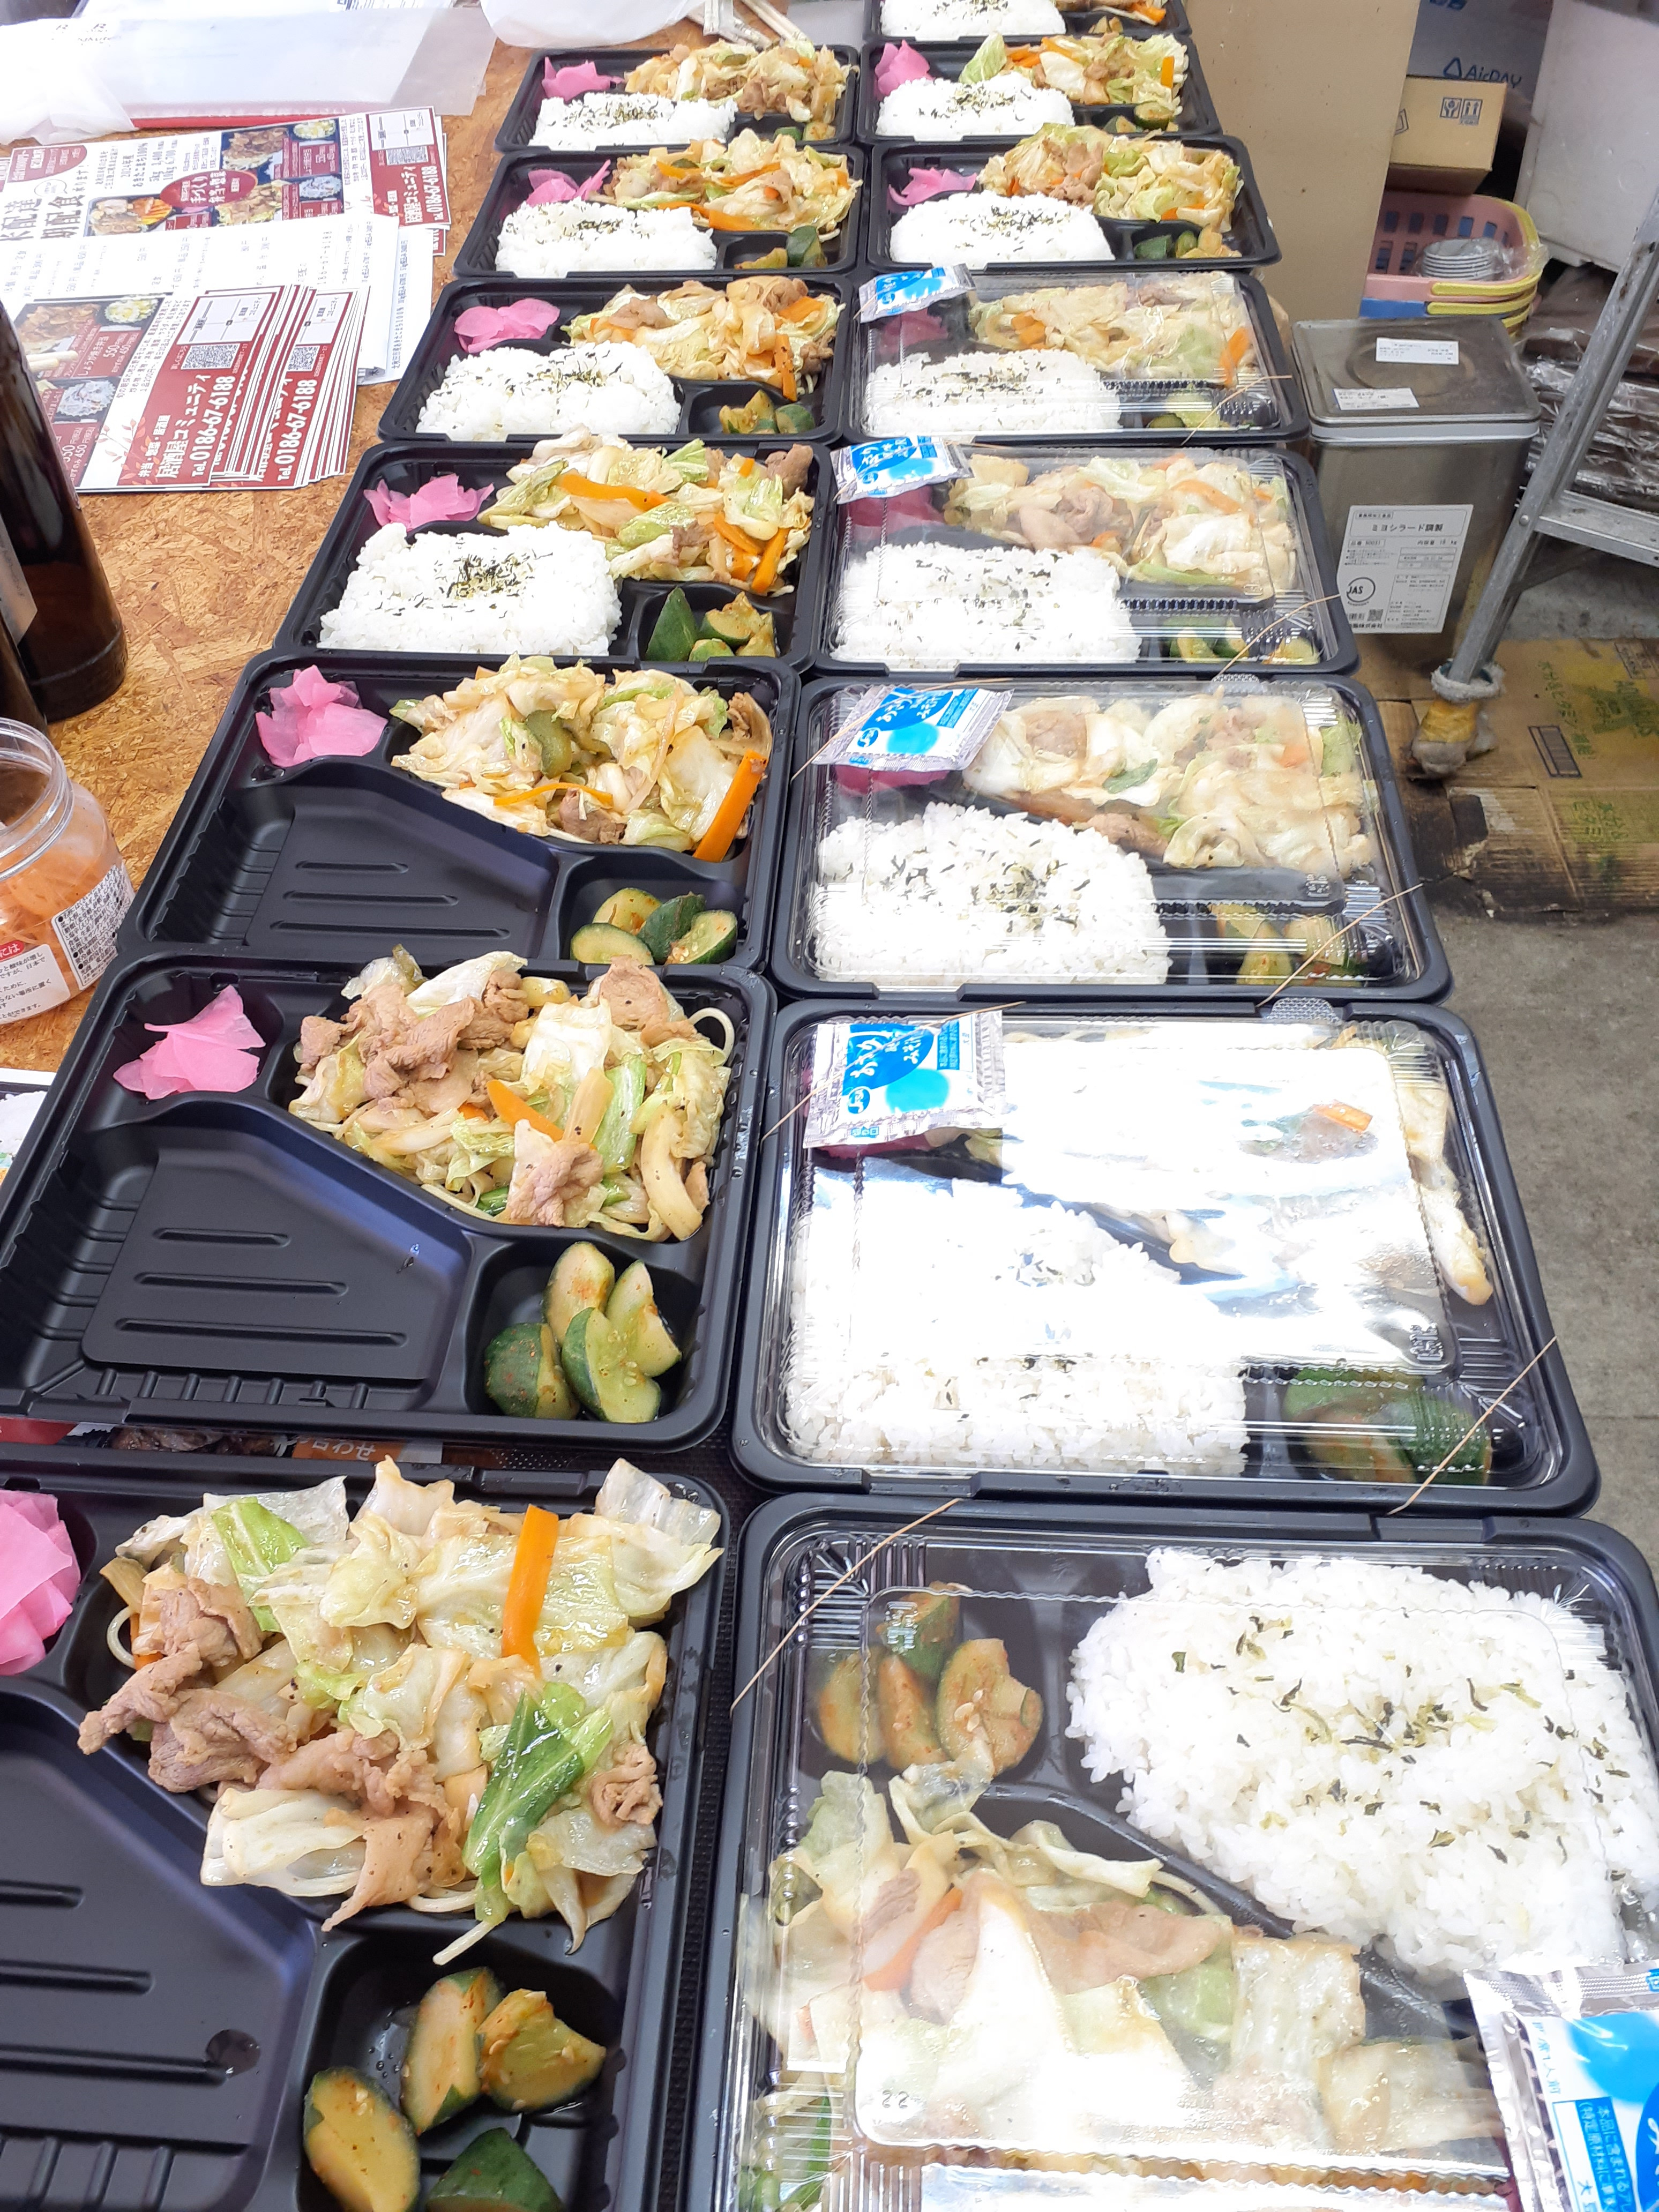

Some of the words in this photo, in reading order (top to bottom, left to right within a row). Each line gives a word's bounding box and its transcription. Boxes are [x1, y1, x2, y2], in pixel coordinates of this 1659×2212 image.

[1466, 64, 1522, 88] AirDAY
[155, 373, 212, 479] 居酒屋コミュニティ
[1347, 585, 1364, 594] JAS
[0, 1004, 41, 1019] とができます。
